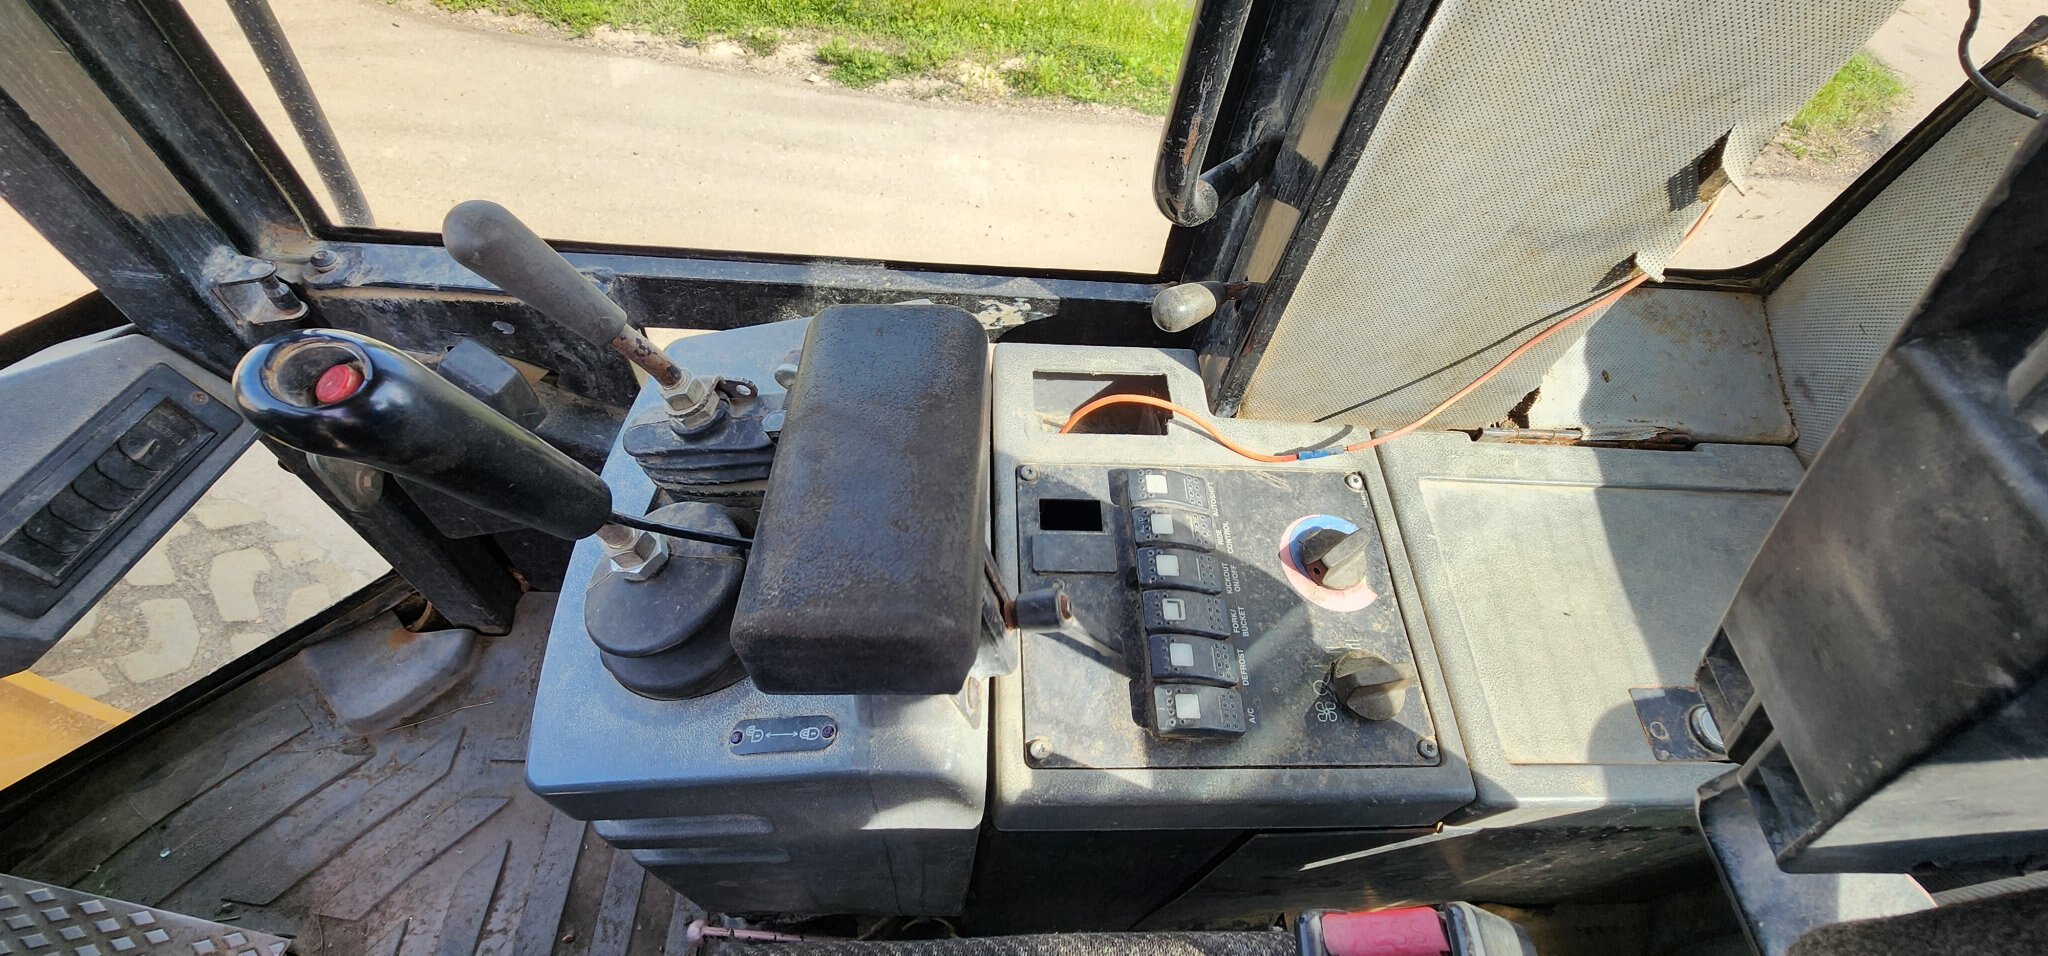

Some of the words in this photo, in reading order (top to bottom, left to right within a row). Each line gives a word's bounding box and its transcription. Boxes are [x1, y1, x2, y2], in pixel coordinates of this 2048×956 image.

[1207, 481, 1220, 518] AUTOSHIFT
[1216, 529, 1225, 545] RIDE
[1223, 521, 1234, 554] CONTROL
[1222, 562, 1233, 594] KICKOUT
[1230, 564, 1241, 593] ON/OFF
[1230, 609, 1240, 634] FORK/
[1238, 605, 1250, 637] BUCKET
[1236, 648, 1250, 686] DEFROST
[1247, 707, 1256, 724] A/C
